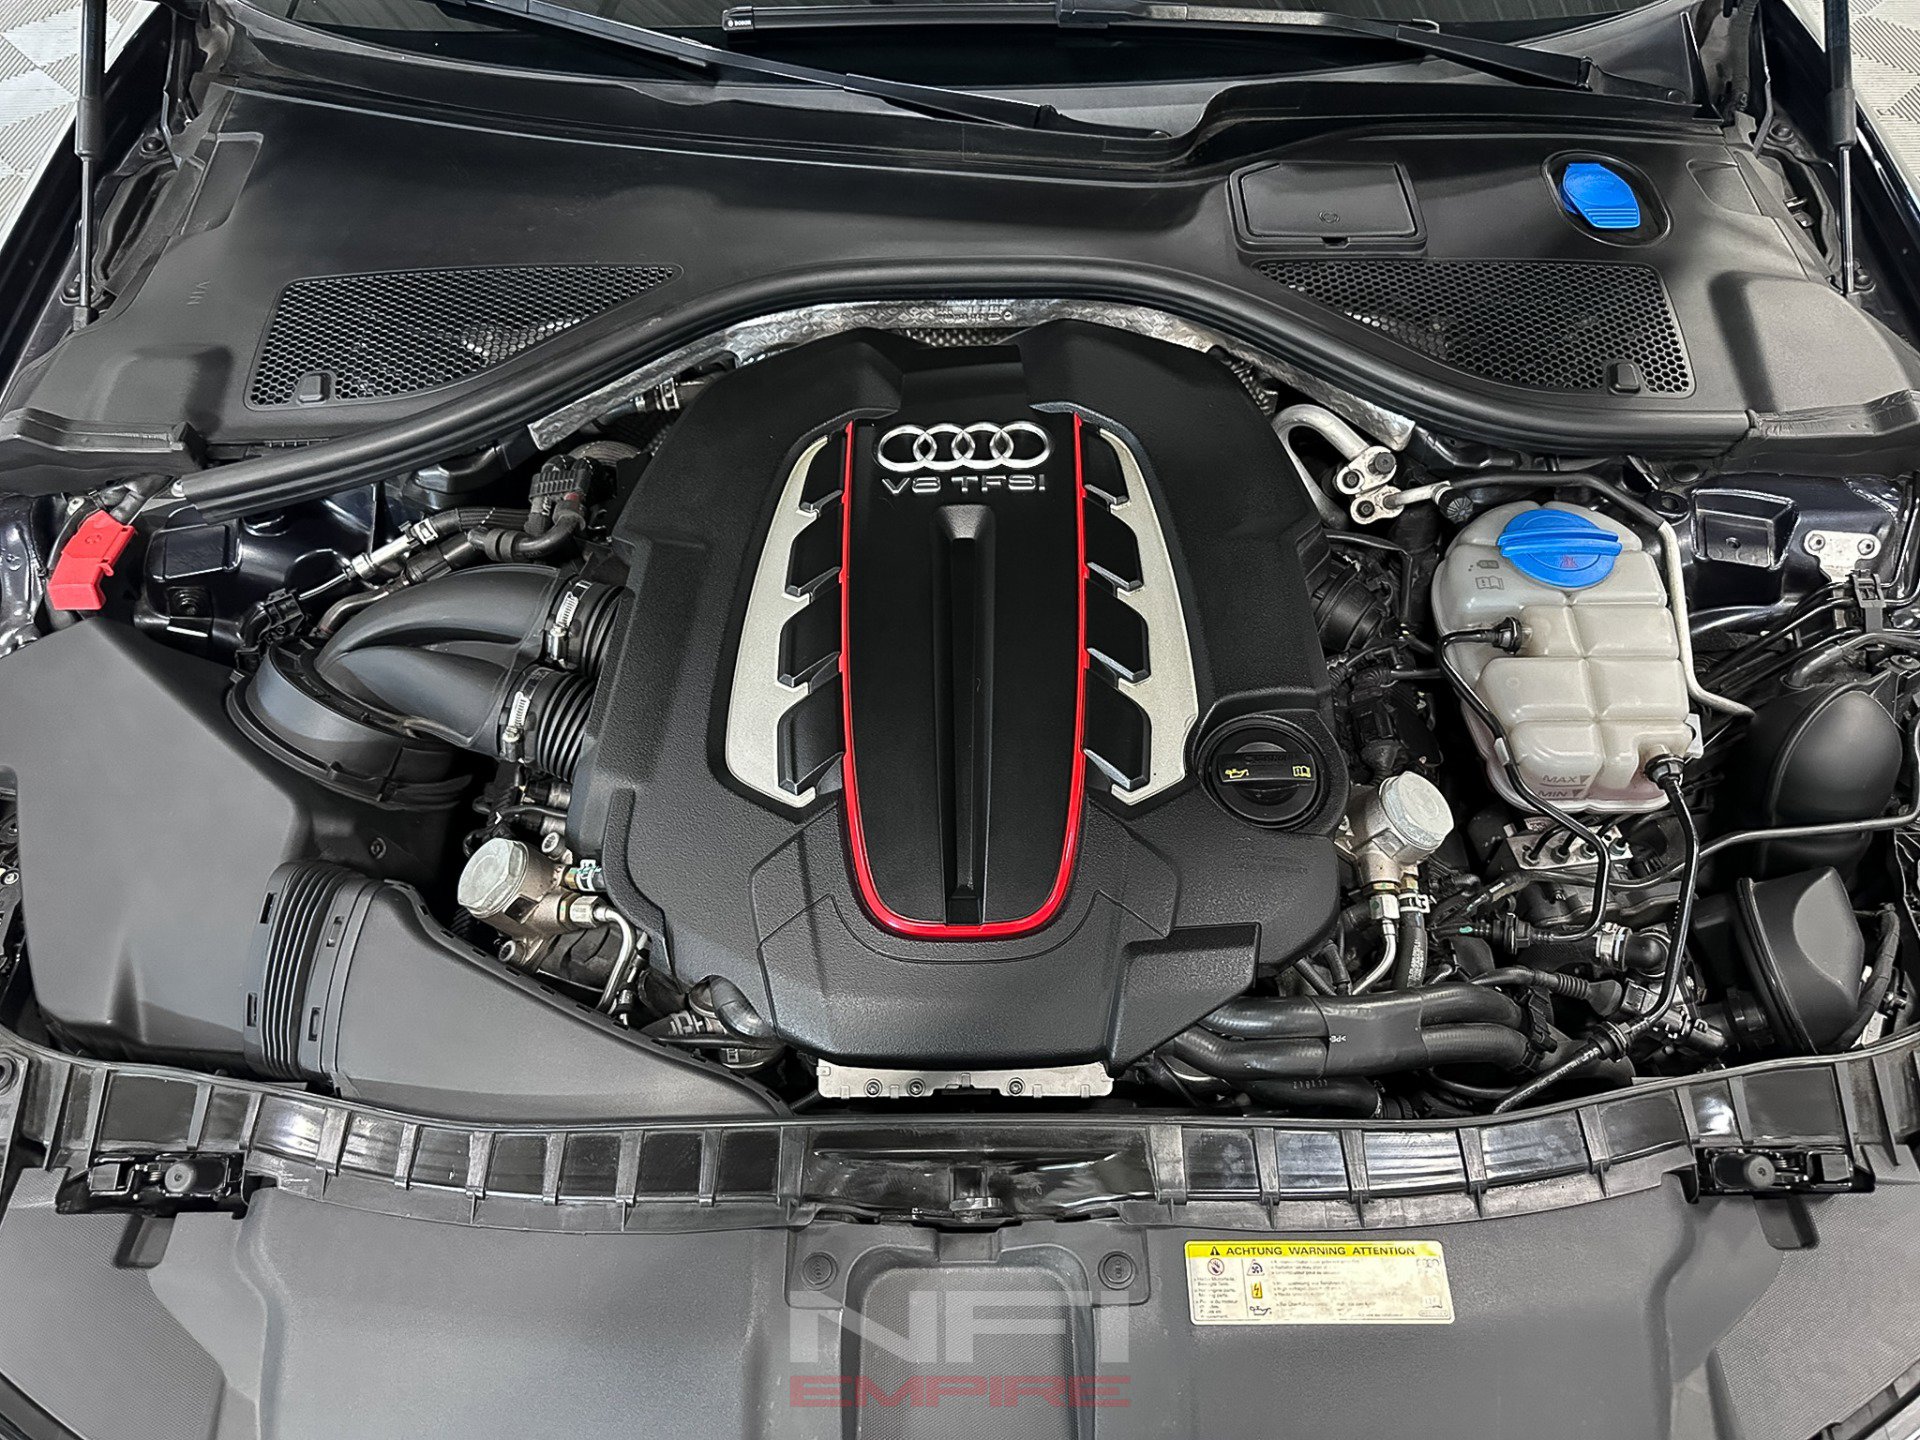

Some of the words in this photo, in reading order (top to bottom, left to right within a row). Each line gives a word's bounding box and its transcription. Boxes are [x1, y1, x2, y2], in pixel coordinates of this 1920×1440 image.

[882, 476, 941, 495] V8
[1542, 774, 1578, 783] MAX
[1226, 1246, 1283, 1256] ACHTUNG
[1288, 1246, 1346, 1256] WARNING
[1352, 1246, 1415, 1256] ATTENTION
